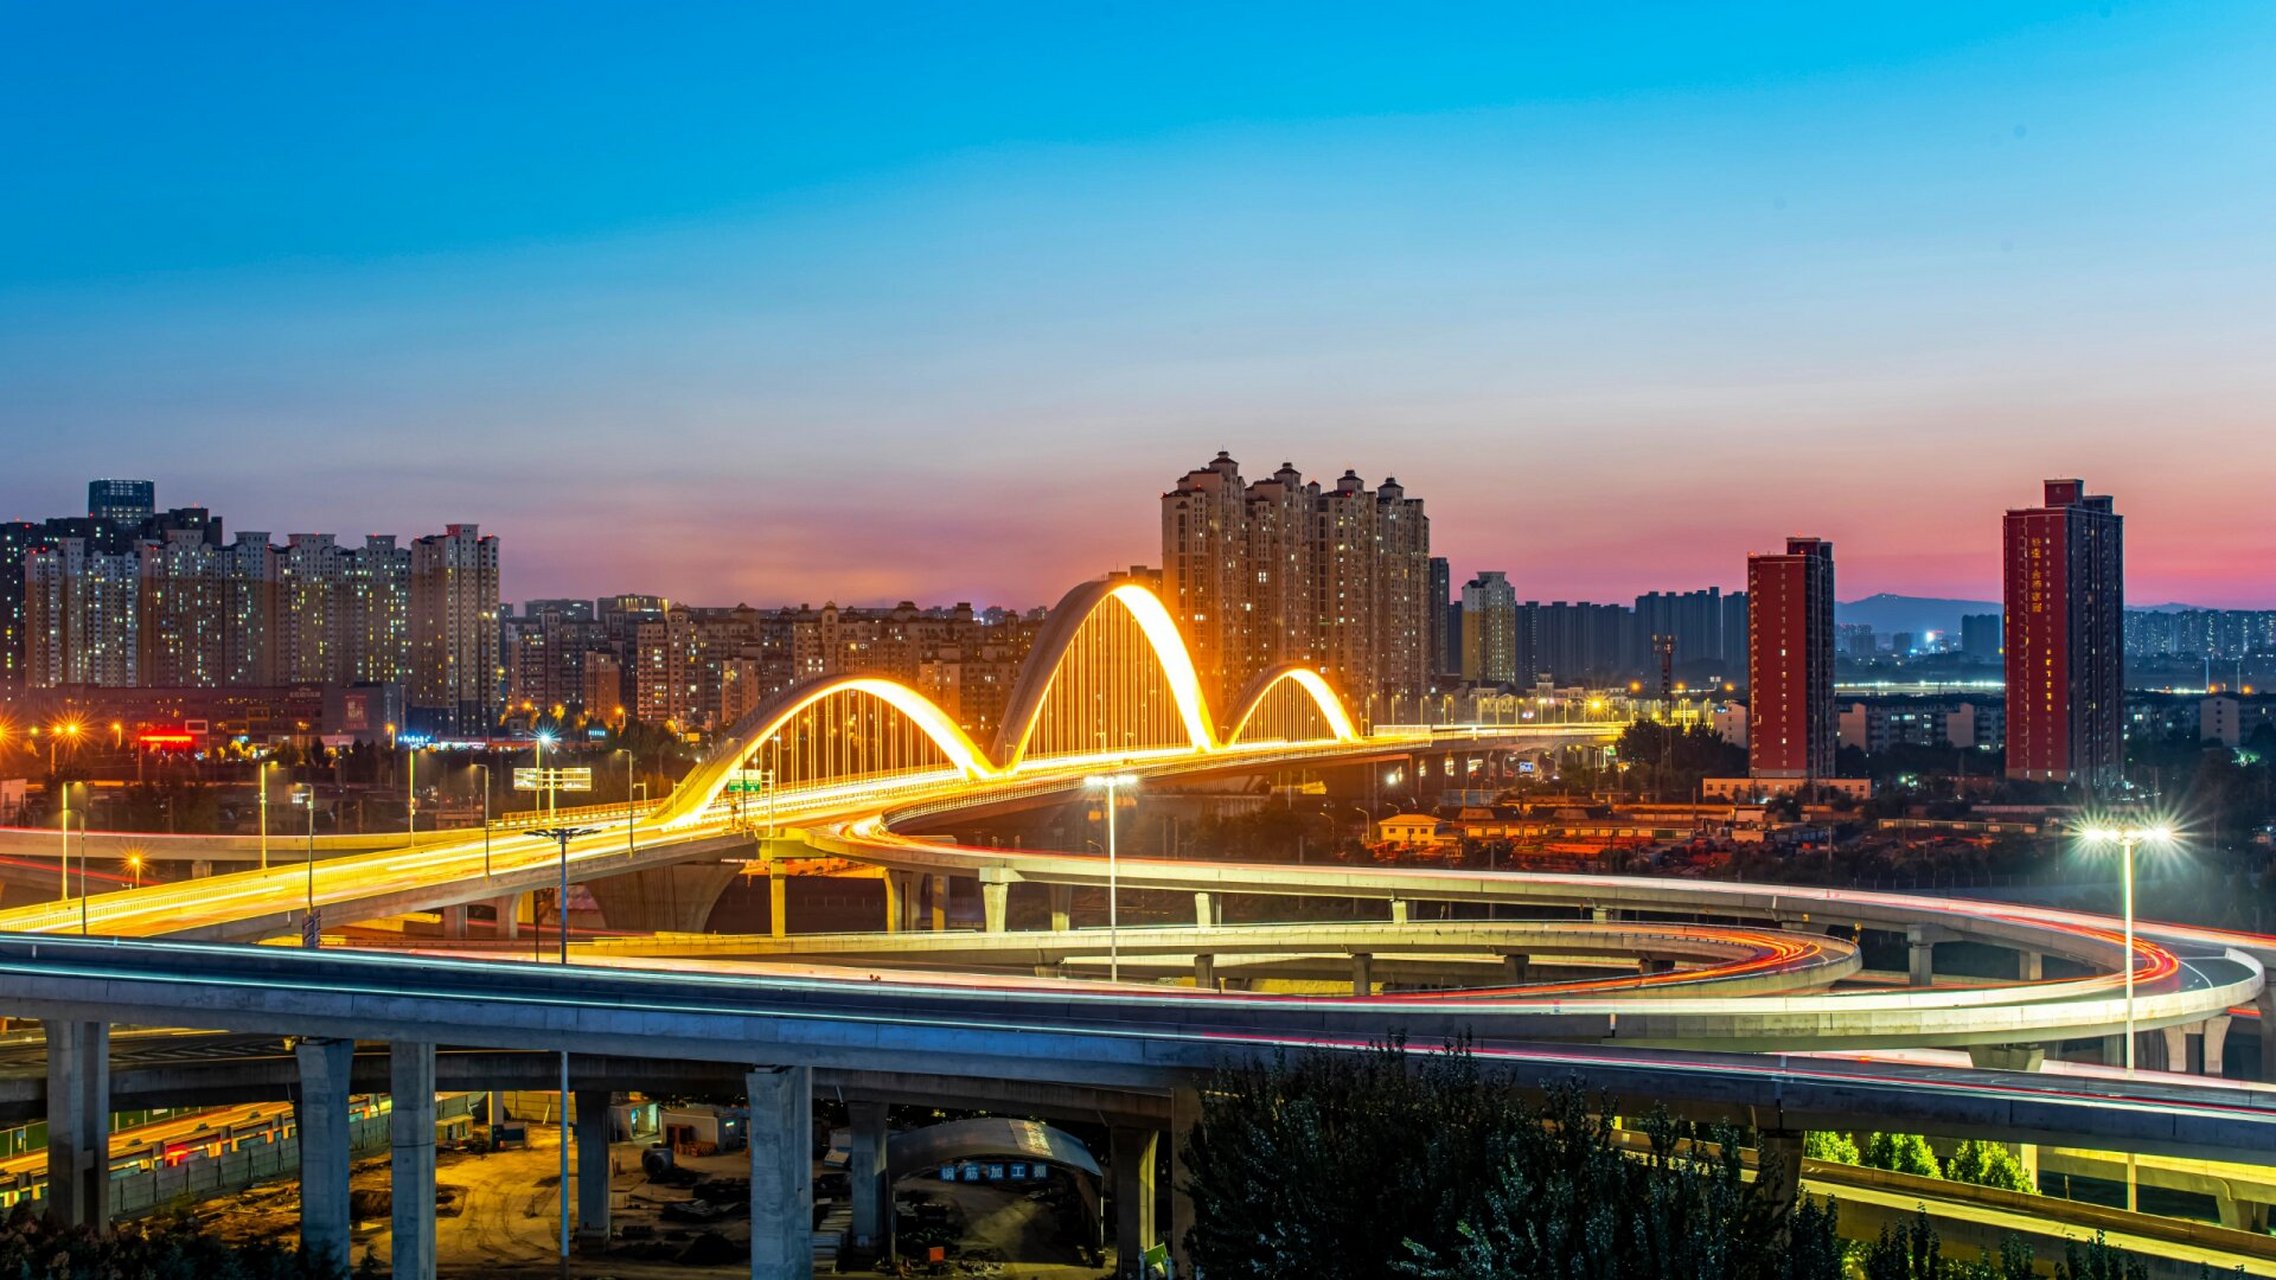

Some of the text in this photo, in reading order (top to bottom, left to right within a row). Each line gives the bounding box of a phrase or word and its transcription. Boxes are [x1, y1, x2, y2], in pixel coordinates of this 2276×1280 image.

[942, 1164, 1047, 1180] 钢筋加工棚
